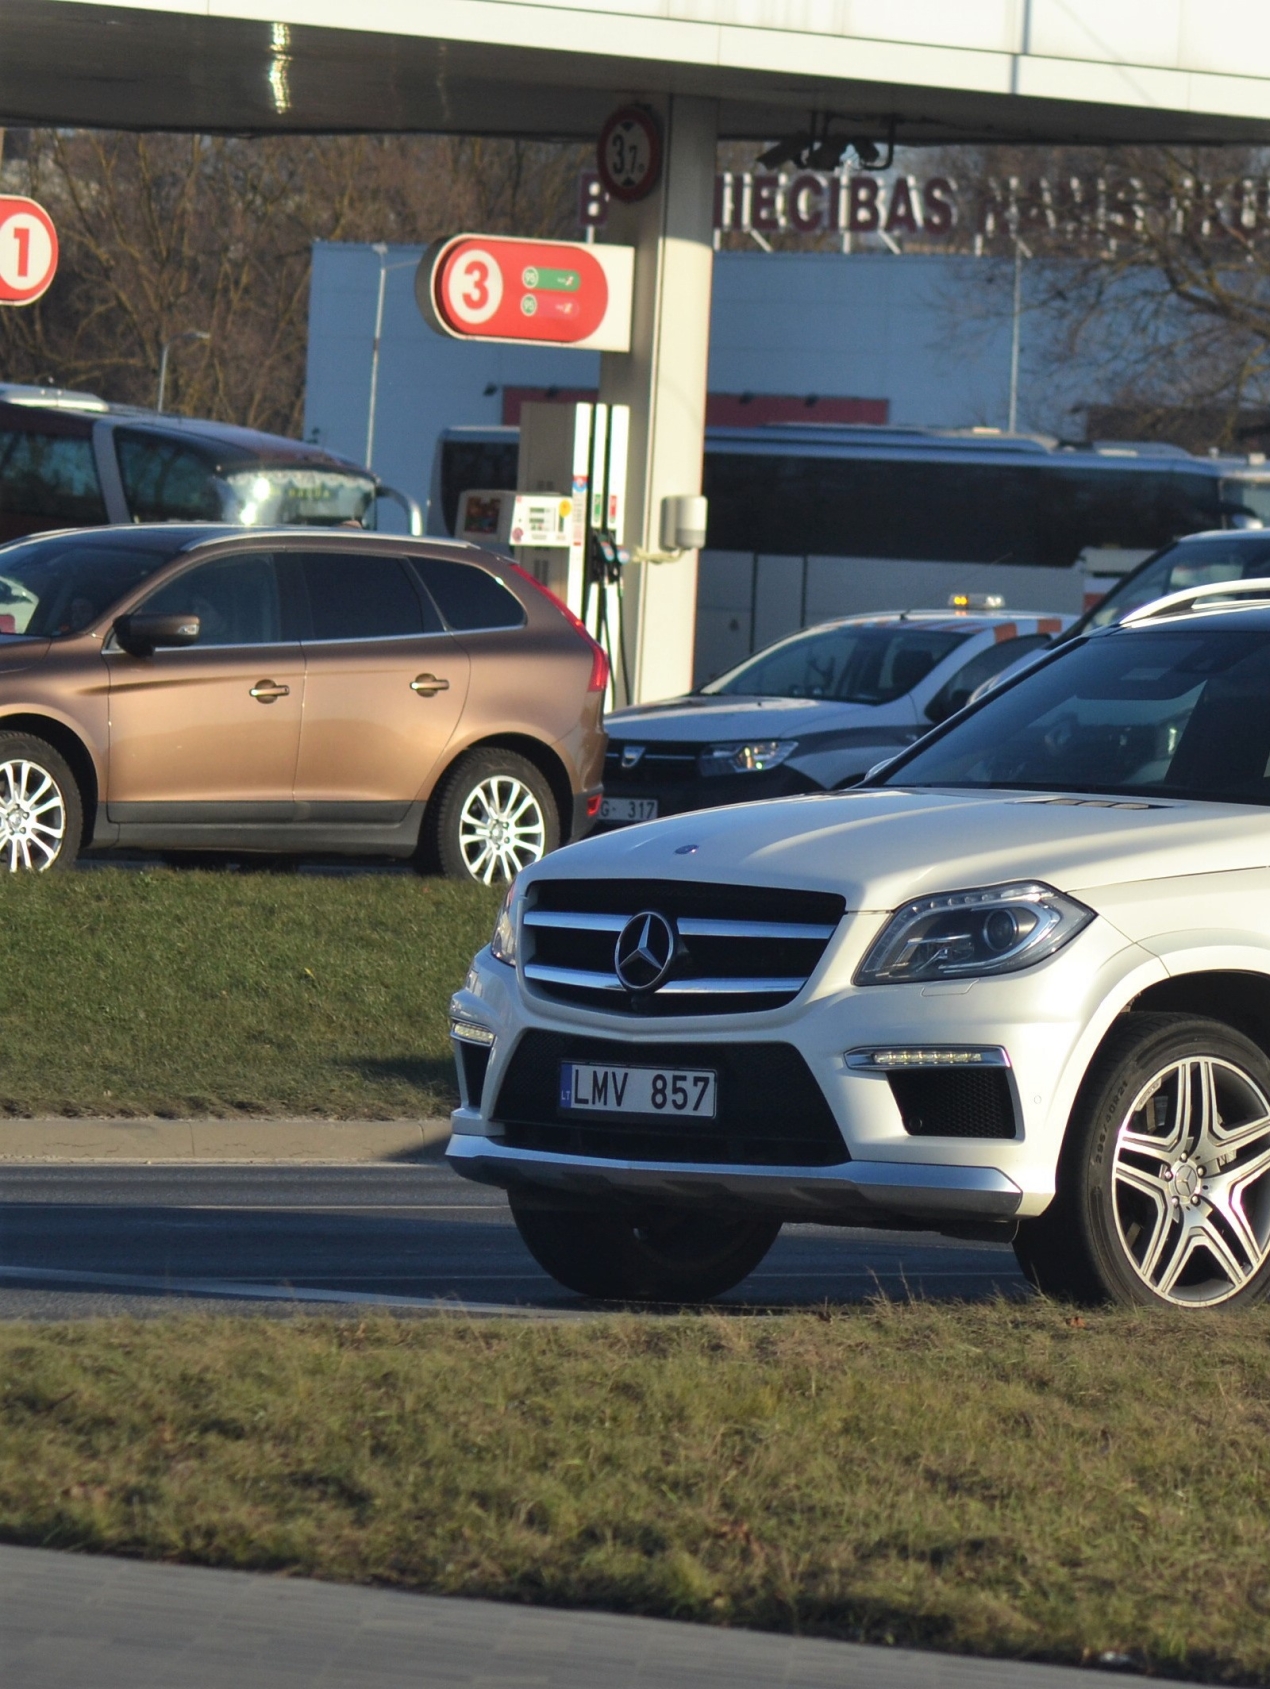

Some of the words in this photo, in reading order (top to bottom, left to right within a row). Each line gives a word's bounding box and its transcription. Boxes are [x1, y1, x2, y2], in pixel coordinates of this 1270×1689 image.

[13, 227, 30, 277] 1
[462, 260, 489, 310] 3
[561, 1090, 571, 1101] LT
[574, 1069, 629, 1107] LMV
[651, 1073, 710, 1111] 857
